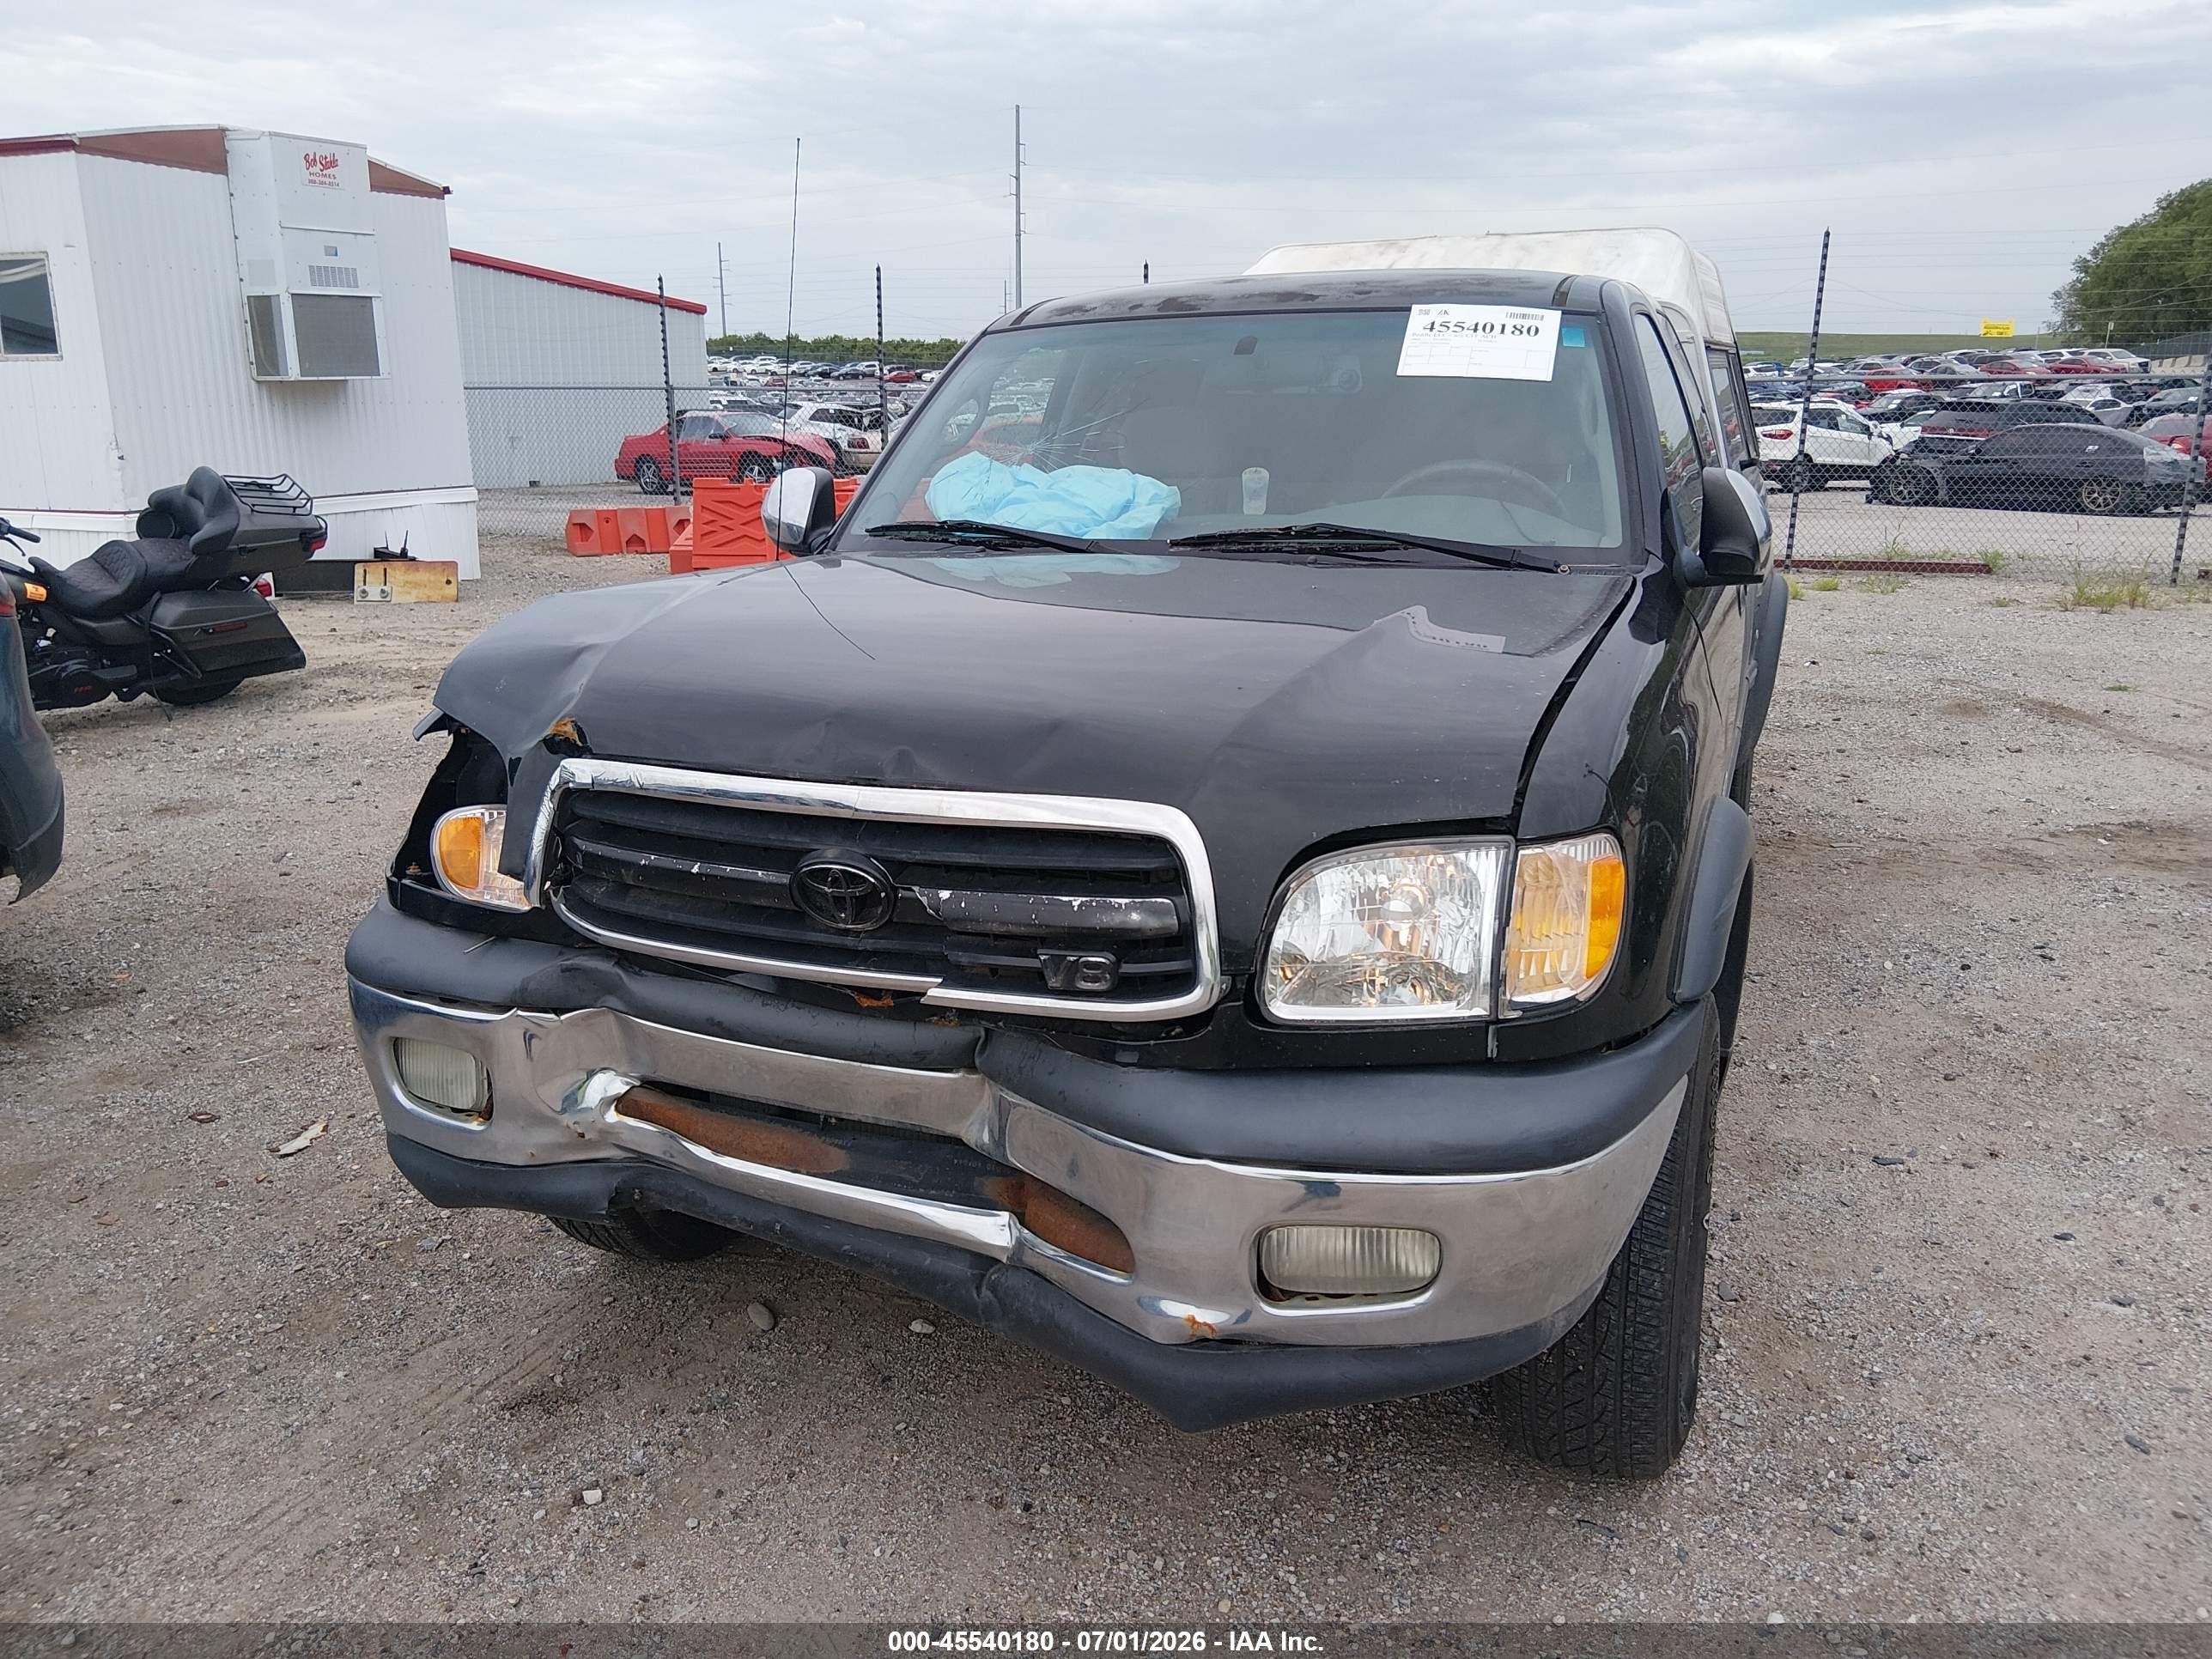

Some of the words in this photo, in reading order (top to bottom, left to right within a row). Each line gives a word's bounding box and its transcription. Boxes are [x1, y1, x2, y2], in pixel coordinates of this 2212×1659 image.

[303, 151, 318, 171] Bob
[309, 171, 337, 179] HOMES
[1423, 319, 1540, 337] 45540180
[1038, 954, 1114, 989] V8
